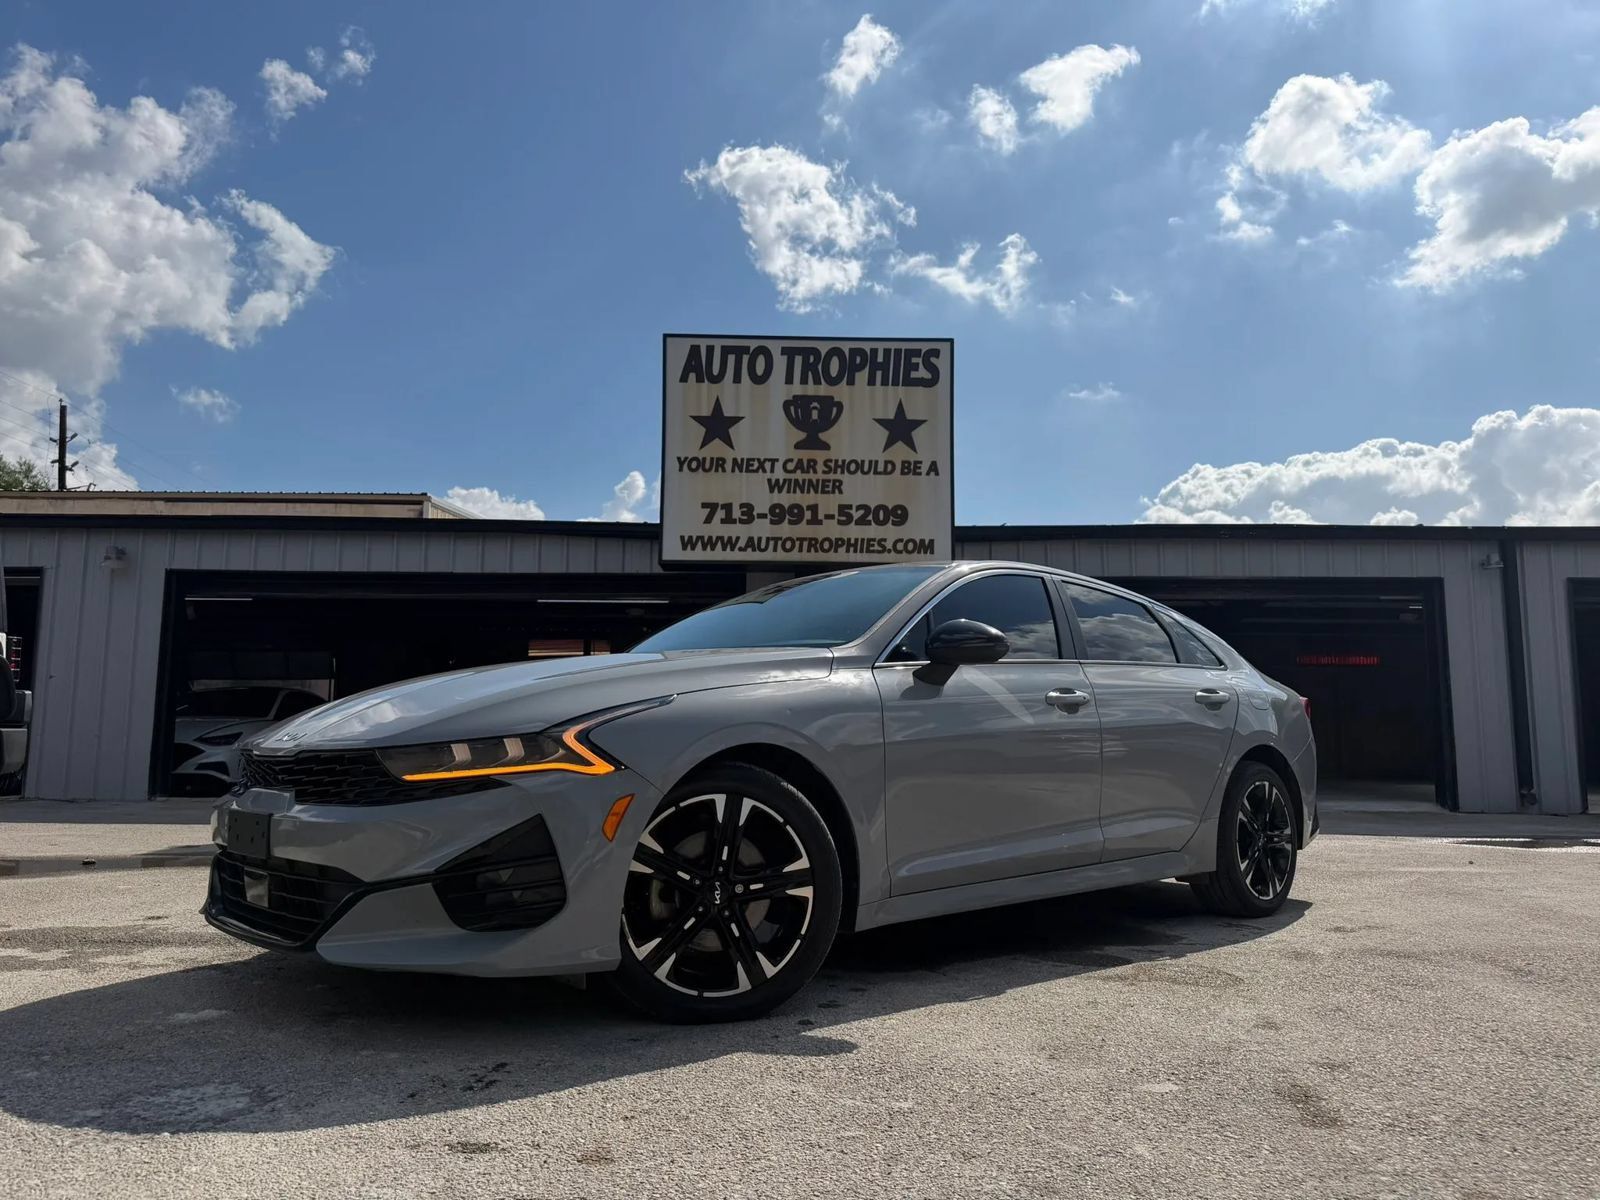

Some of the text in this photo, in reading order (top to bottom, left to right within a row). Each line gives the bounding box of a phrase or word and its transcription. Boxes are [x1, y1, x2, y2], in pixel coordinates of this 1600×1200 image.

[679, 344, 941, 388] AUTO TROPHIES
[676, 456, 940, 477] YOUR NEXT CAR SHOULD BE A
[767, 478, 844, 495] WINNER
[701, 502, 909, 527] 713-991-5209
[679, 535, 936, 555] WWW.AUTOTROPHIES.COM
